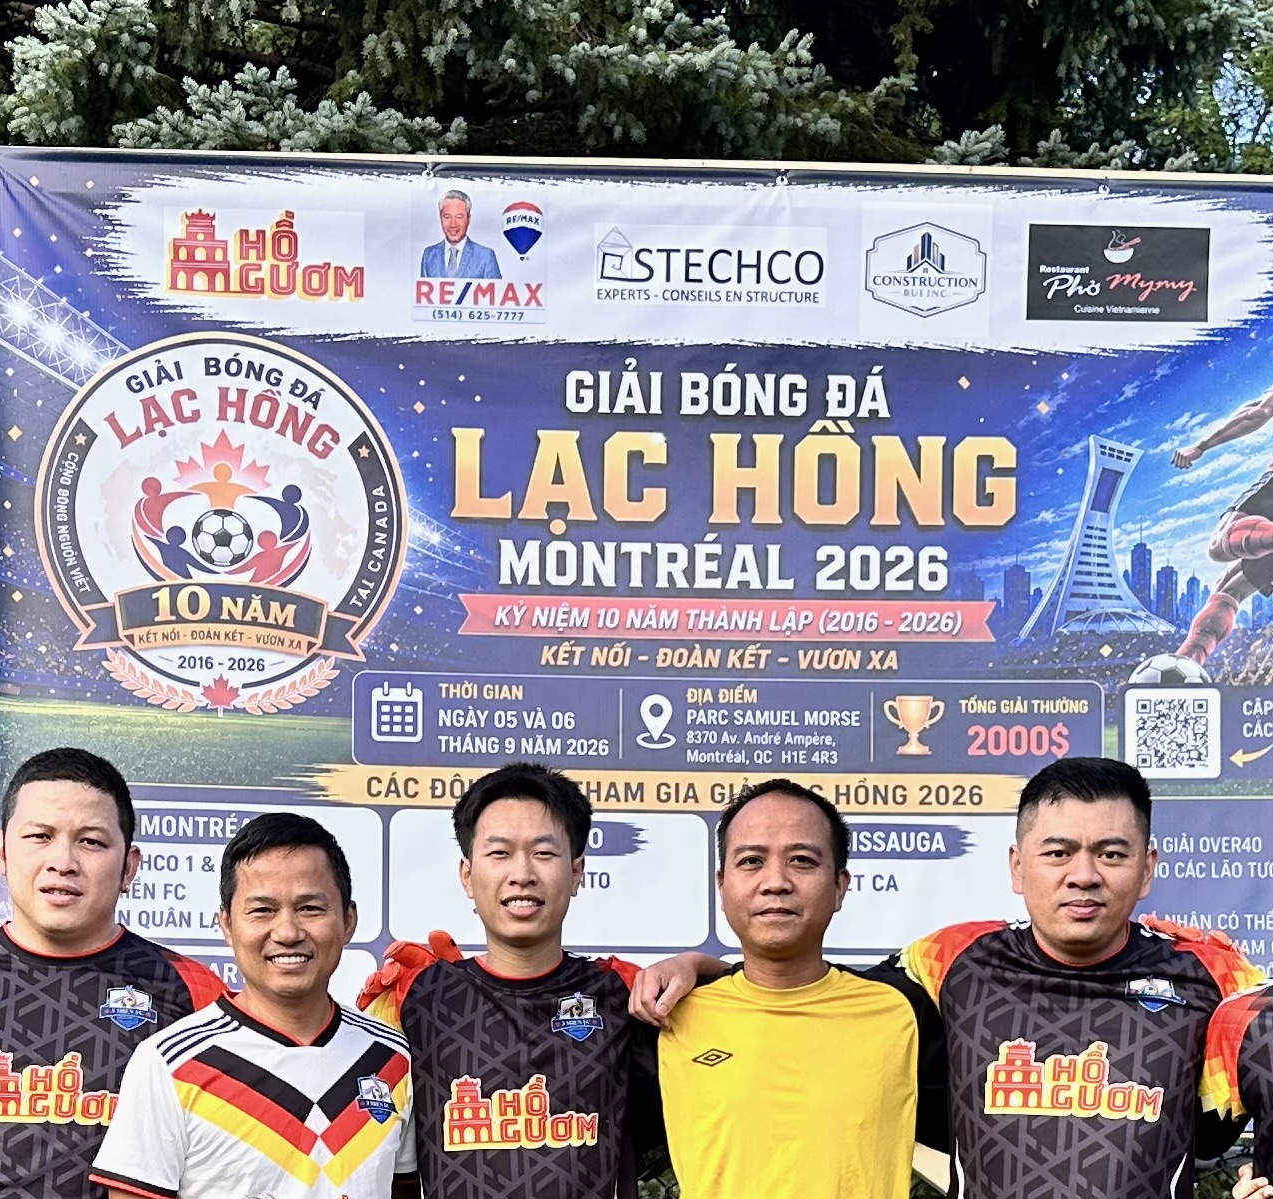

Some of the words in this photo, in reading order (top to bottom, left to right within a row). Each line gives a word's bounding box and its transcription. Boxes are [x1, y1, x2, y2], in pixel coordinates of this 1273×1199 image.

[506, 214, 540, 227] RE/MAX
[238, 209, 299, 263] HỒ
[634, 247, 824, 286] STECHCO
[1039, 264, 1090, 275] Restaurant
[238, 261, 365, 298] GƯƠM
[872, 275, 978, 289] CONSTRUCTION
[1105, 272, 1197, 302] Mymy
[415, 280, 544, 307] RE/MAX
[596, 288, 650, 301] EXPERTS
[662, 288, 722, 302] CONSEILS
[725, 290, 742, 303] EN
[745, 291, 819, 304] STRUCTURE
[903, 288, 923, 298] BUI
[926, 289, 950, 299] INC.
[431, 309, 463, 321] (514)
[468, 310, 525, 322] 625-7777
[1073, 304, 1105, 314] Cuisine
[1105, 304, 1160, 315] Vietnamienne
[125, 358, 184, 394] GIẢI
[203, 352, 284, 387] BÓNG
[287, 377, 326, 411] ĐÁ
[565, 357, 664, 415] GIẢI
[679, 361, 808, 417] BÓNG
[825, 364, 892, 418] ĐÁ
[103, 387, 201, 450] LẠC
[215, 385, 341, 460] HỒNG
[449, 426, 668, 536] LẠC
[707, 418, 1017, 526] HỒNG
[367, 484, 389, 573] CANADA
[497, 532, 795, 590] MONTRÉAL
[814, 545, 949, 592] 2026
[151, 584, 211, 622] 10
[219, 593, 298, 628] NĂM
[494, 600, 528, 627] KỶ
[531, 602, 592, 632] NIỆM
[596, 607, 620, 629] 10
[625, 603, 680, 631] NĂM
[685, 605, 764, 632] THÀNH
[768, 606, 814, 636] LẬP
[818, 609, 880, 636] (2016
[897, 609, 963, 637] 2026)
[287, 638, 303, 651] XA
[540, 640, 586, 666] KẾT
[590, 641, 632, 667] NỐI
[655, 643, 722, 668] ĐOÀN
[726, 643, 772, 669] KẾT
[797, 646, 862, 670] VƯƠN
[866, 649, 898, 670] XA
[177, 654, 214, 670] 2016
[227, 657, 266, 672] 2026
[438, 680, 478, 700] THỜI
[482, 684, 523, 701] GIAN
[686, 687, 714, 706] ĐỊA
[1000, 695, 1028, 714] GIẢI
[1242, 696, 1273, 719] CẬP
[438, 705, 490, 728] NGÀY
[493, 711, 518, 729] 05
[522, 706, 547, 730] VÀ
[551, 711, 576, 730] 06
[686, 709, 729, 726] PARC
[733, 709, 800, 726] SAMUEL
[804, 710, 861, 727] MORSE
[1242, 719, 1273, 738] CÁC
[438, 732, 500, 754] THÁNG
[504, 737, 516, 754] 9
[520, 733, 562, 756] NĂM
[566, 738, 610, 756] 2026
[686, 731, 718, 745] 8370
[720, 731, 741, 745] Av.
[743, 731, 782, 745] André
[784, 731, 837, 748] Ampère,
[966, 721, 1070, 759] 2000$
[686, 749, 750, 766] Montréal,
[753, 750, 773, 765] QC
[781, 750, 807, 764] H1E
[810, 751, 839, 765] 4R3
[366, 771, 420, 800] CÁC
[656, 781, 700, 804] GIA
[918, 784, 984, 806] 2026
[140, 812, 251, 839] MONTRÉ
[851, 830, 946, 853] ISSAUGA
[1162, 832, 1193, 853] GIẢI
[1198, 836, 1263, 853] OVER40
[185, 855, 193, 872] 1
[200, 855, 216, 872] &
[1174, 858, 1207, 879] CÁC
[1210, 858, 1243, 879] LÃO
[163, 882, 187, 901] FC
[871, 874, 900, 893] CA
[137, 906, 192, 930] QUÂN
[199, 911, 221, 933] LẠ
[1216, 910, 1240, 930] CÓ
[28, 1055, 83, 1093] HỒ
[1050, 1043, 1109, 1083] HỒ
[498, 1076, 550, 1117] HỒ
[1054, 1082, 1163, 1117] GƯƠM
[499, 1113, 599, 1143] GƯƠM
